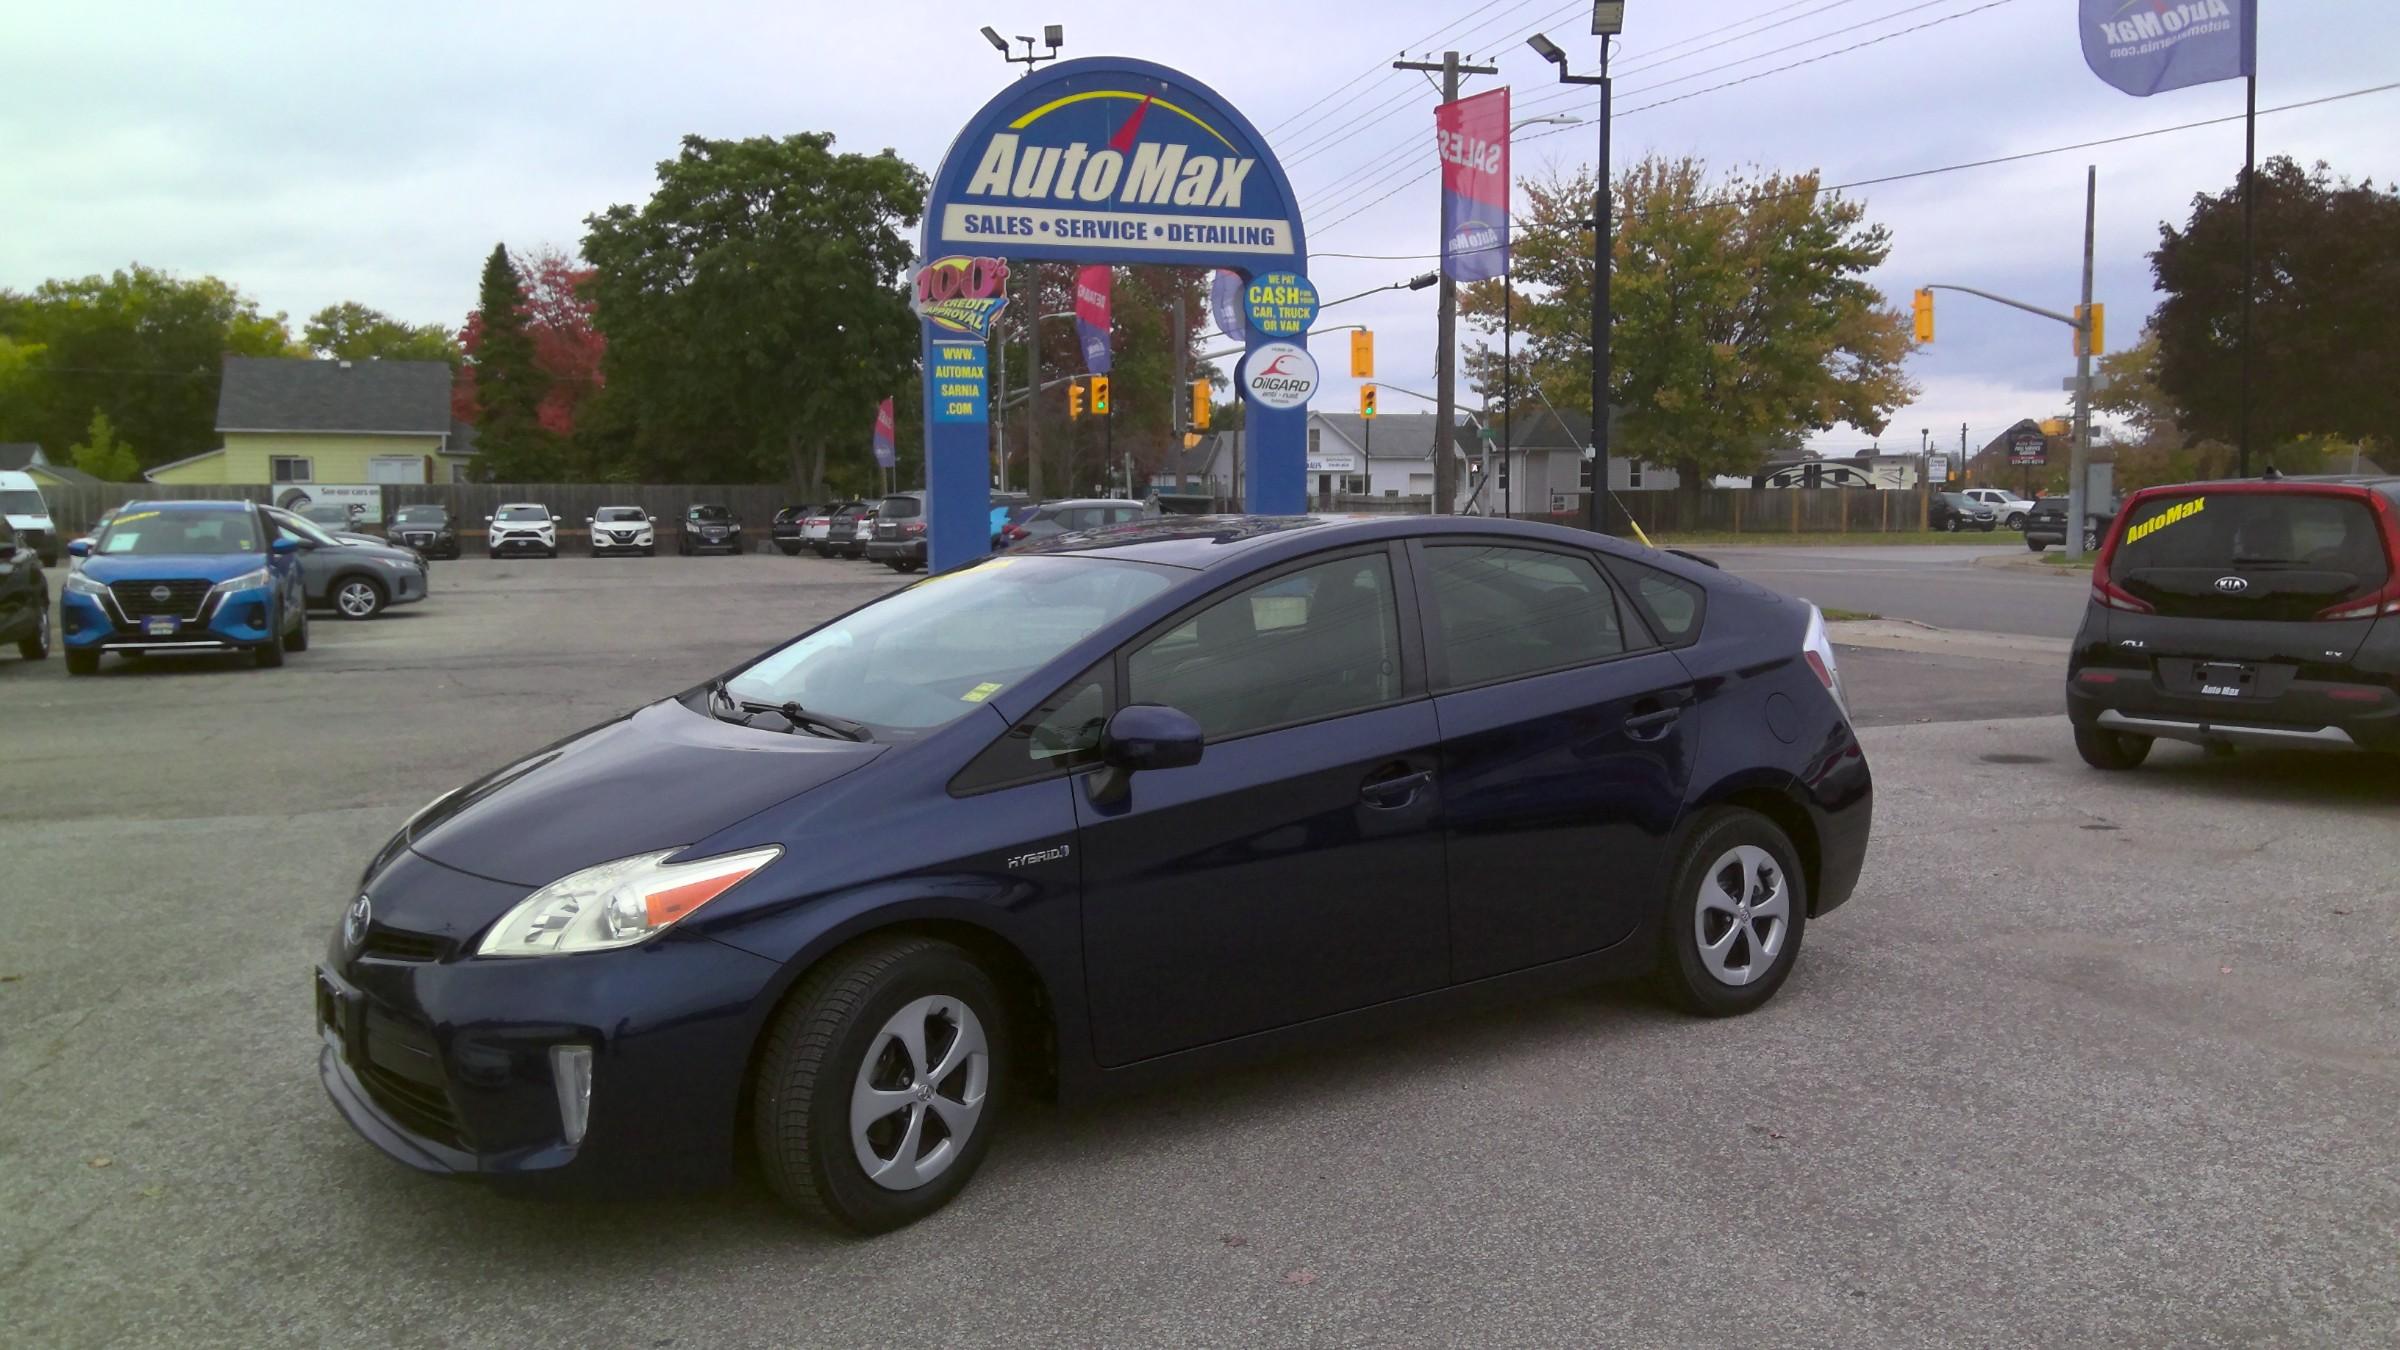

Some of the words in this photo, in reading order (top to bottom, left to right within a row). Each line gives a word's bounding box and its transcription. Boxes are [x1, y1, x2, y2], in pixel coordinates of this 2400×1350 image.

[965, 214, 1033, 236] SALES
[1055, 218, 1148, 241] SERVICE
[1168, 222, 1275, 246] DETAILING
[916, 256, 1010, 302] 100%
[1268, 274, 1280, 284] WE
[1281, 274, 1295, 285] PAY
[943, 298, 996, 312] CREDIT
[926, 305, 984, 330] APPROVAL
[1279, 307, 1310, 319] TRUCK
[1264, 320, 1277, 332] OR
[1280, 320, 1299, 332] VAN
[943, 347, 976, 361] WWW.
[936, 366, 984, 379] AUTOMAX
[941, 384, 979, 397] SARNIA
[1252, 377, 1310, 392] OilGARD
[946, 402, 973, 415] .COM
[2201, 685, 2221, 695] Auto
[2221, 686, 2240, 696] Max
[1008, 848, 1062, 869] HYBRID
